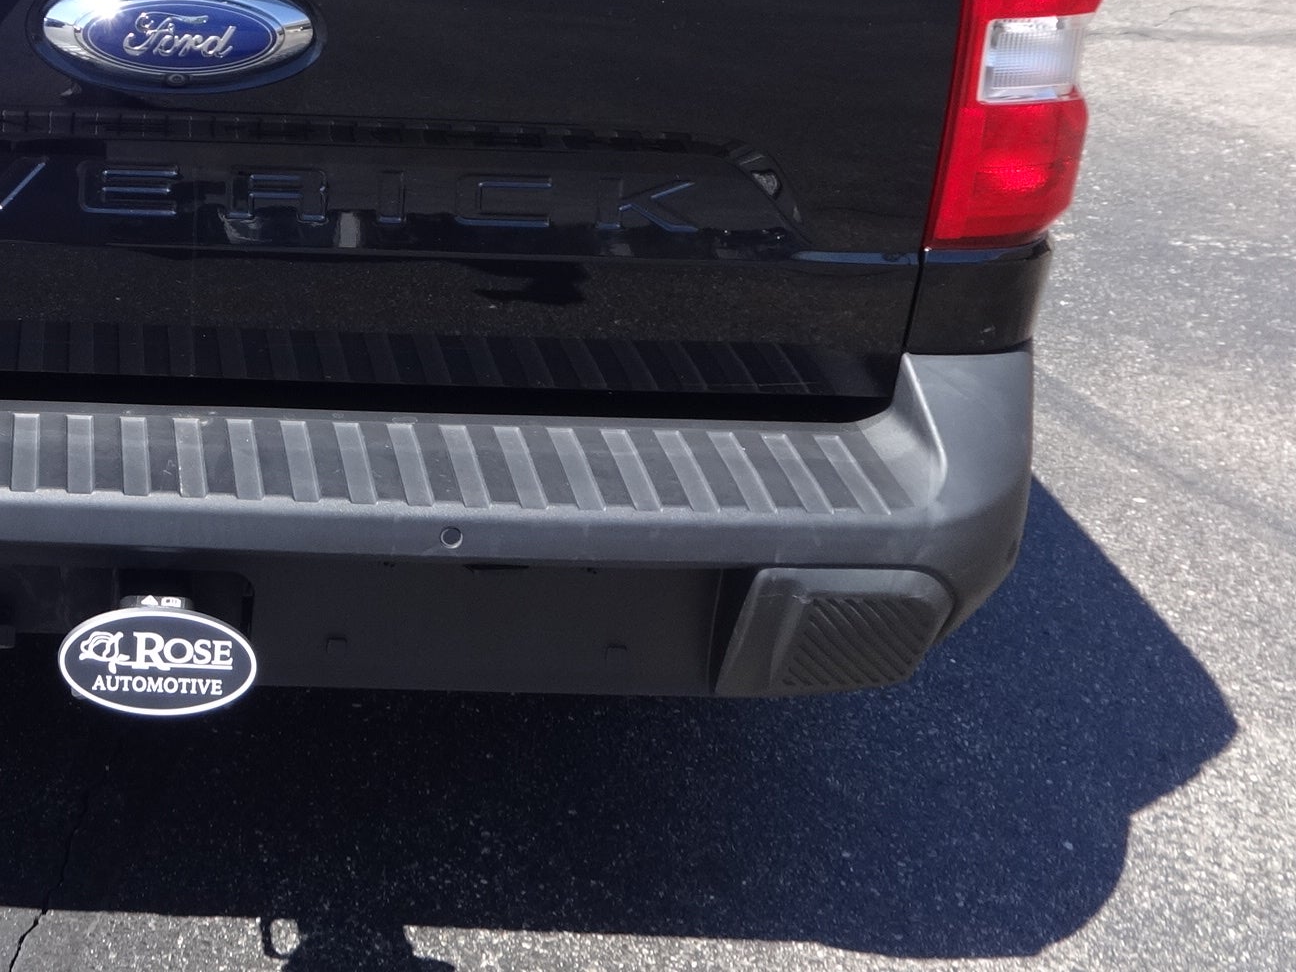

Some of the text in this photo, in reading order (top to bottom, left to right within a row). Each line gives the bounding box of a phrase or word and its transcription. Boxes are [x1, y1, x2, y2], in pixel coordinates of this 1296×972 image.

[123, 11, 236, 58] Ford
[132, 631, 234, 672] ROSE
[91, 674, 223, 696] AUTOMOTIVE
